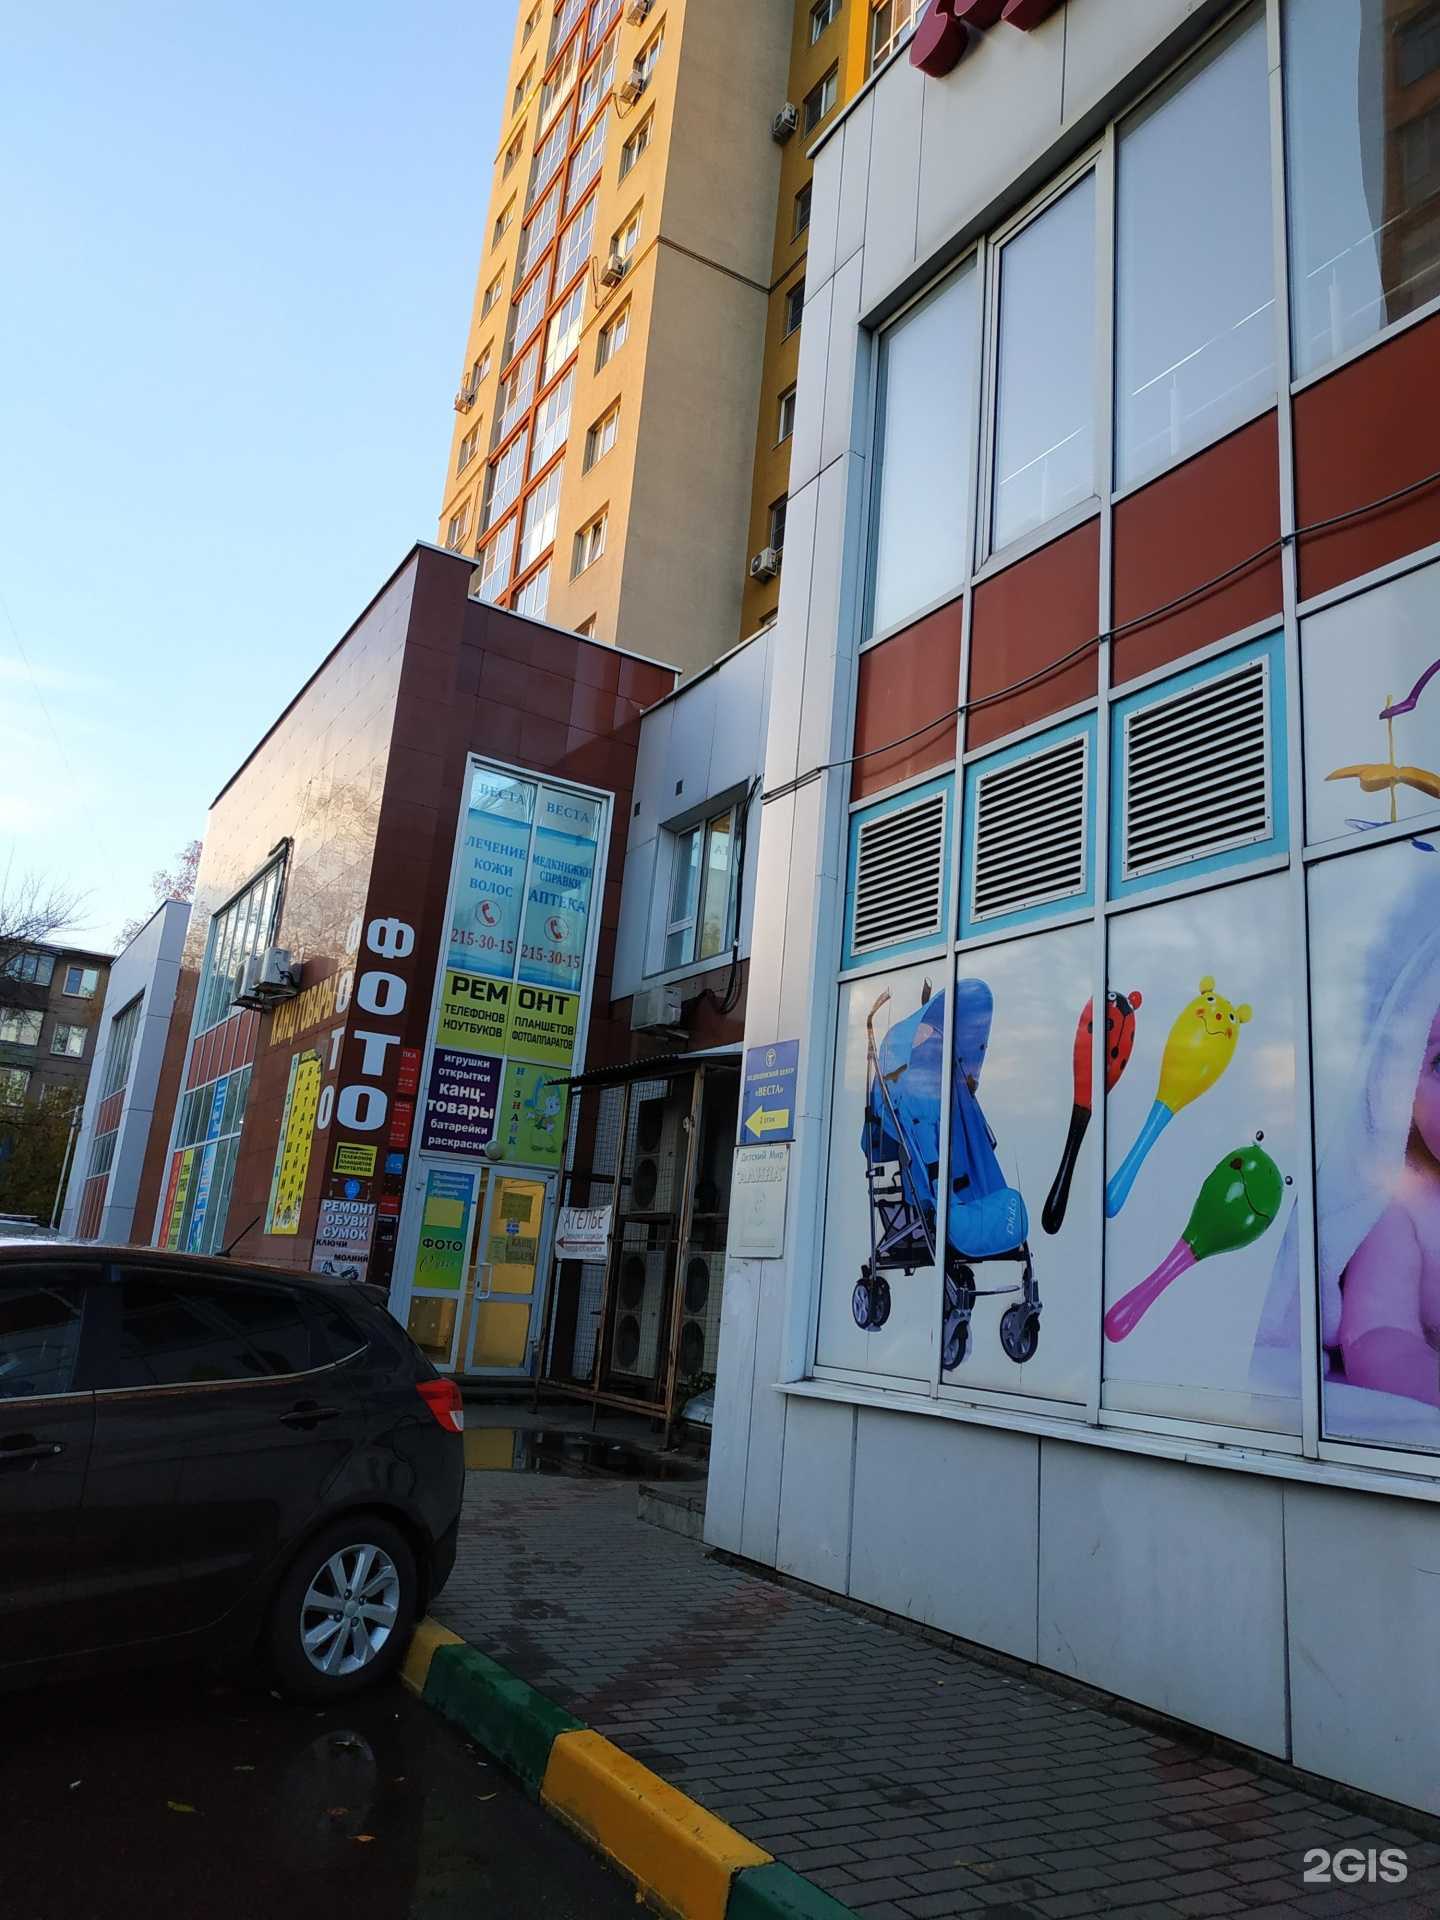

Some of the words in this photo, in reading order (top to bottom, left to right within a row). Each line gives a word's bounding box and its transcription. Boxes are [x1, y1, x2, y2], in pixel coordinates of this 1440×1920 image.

[480, 783, 525, 806] ВЕСТА
[546, 801, 590, 824] ВЕСТА
[464, 836, 527, 861] ЛЕЧЕНИЕ
[474, 858, 513, 878] КОЖИ
[469, 878, 513, 898] ВОЛОС
[539, 869, 582, 890] СПРАВКИ
[528, 888, 586, 913] АПТЕКА
[450, 928, 514, 954] 215-30-15
[521, 943, 581, 969] 215-30-15
[317, 912, 363, 1130] ФОТО
[444, 1003, 505, 1024] ТЕЛЕФОНОВ
[337, 917, 416, 1131] ФОТО
[443, 1018, 503, 1038] НОУТБУКОВ
[514, 1016, 575, 1036] ПЛАНШЕТОВ
[511, 1030, 574, 1050] ФОТОАППАРАТОВ
[443, 1054, 490, 1069] игрушки
[438, 1068, 491, 1083] открытки
[439, 1082, 486, 1103] канц-
[427, 1099, 495, 1121] товары
[430, 1117, 489, 1136] батарейки
[427, 1136, 486, 1150] раскраски
[323, 1200, 376, 1216] РЕМОНТ
[326, 1214, 369, 1228] ОБУВИ
[316, 1238, 348, 1248] КЛЮЧИ
[322, 1226, 368, 1241] СУМОК
[422, 1238, 463, 1251] ФОТО
